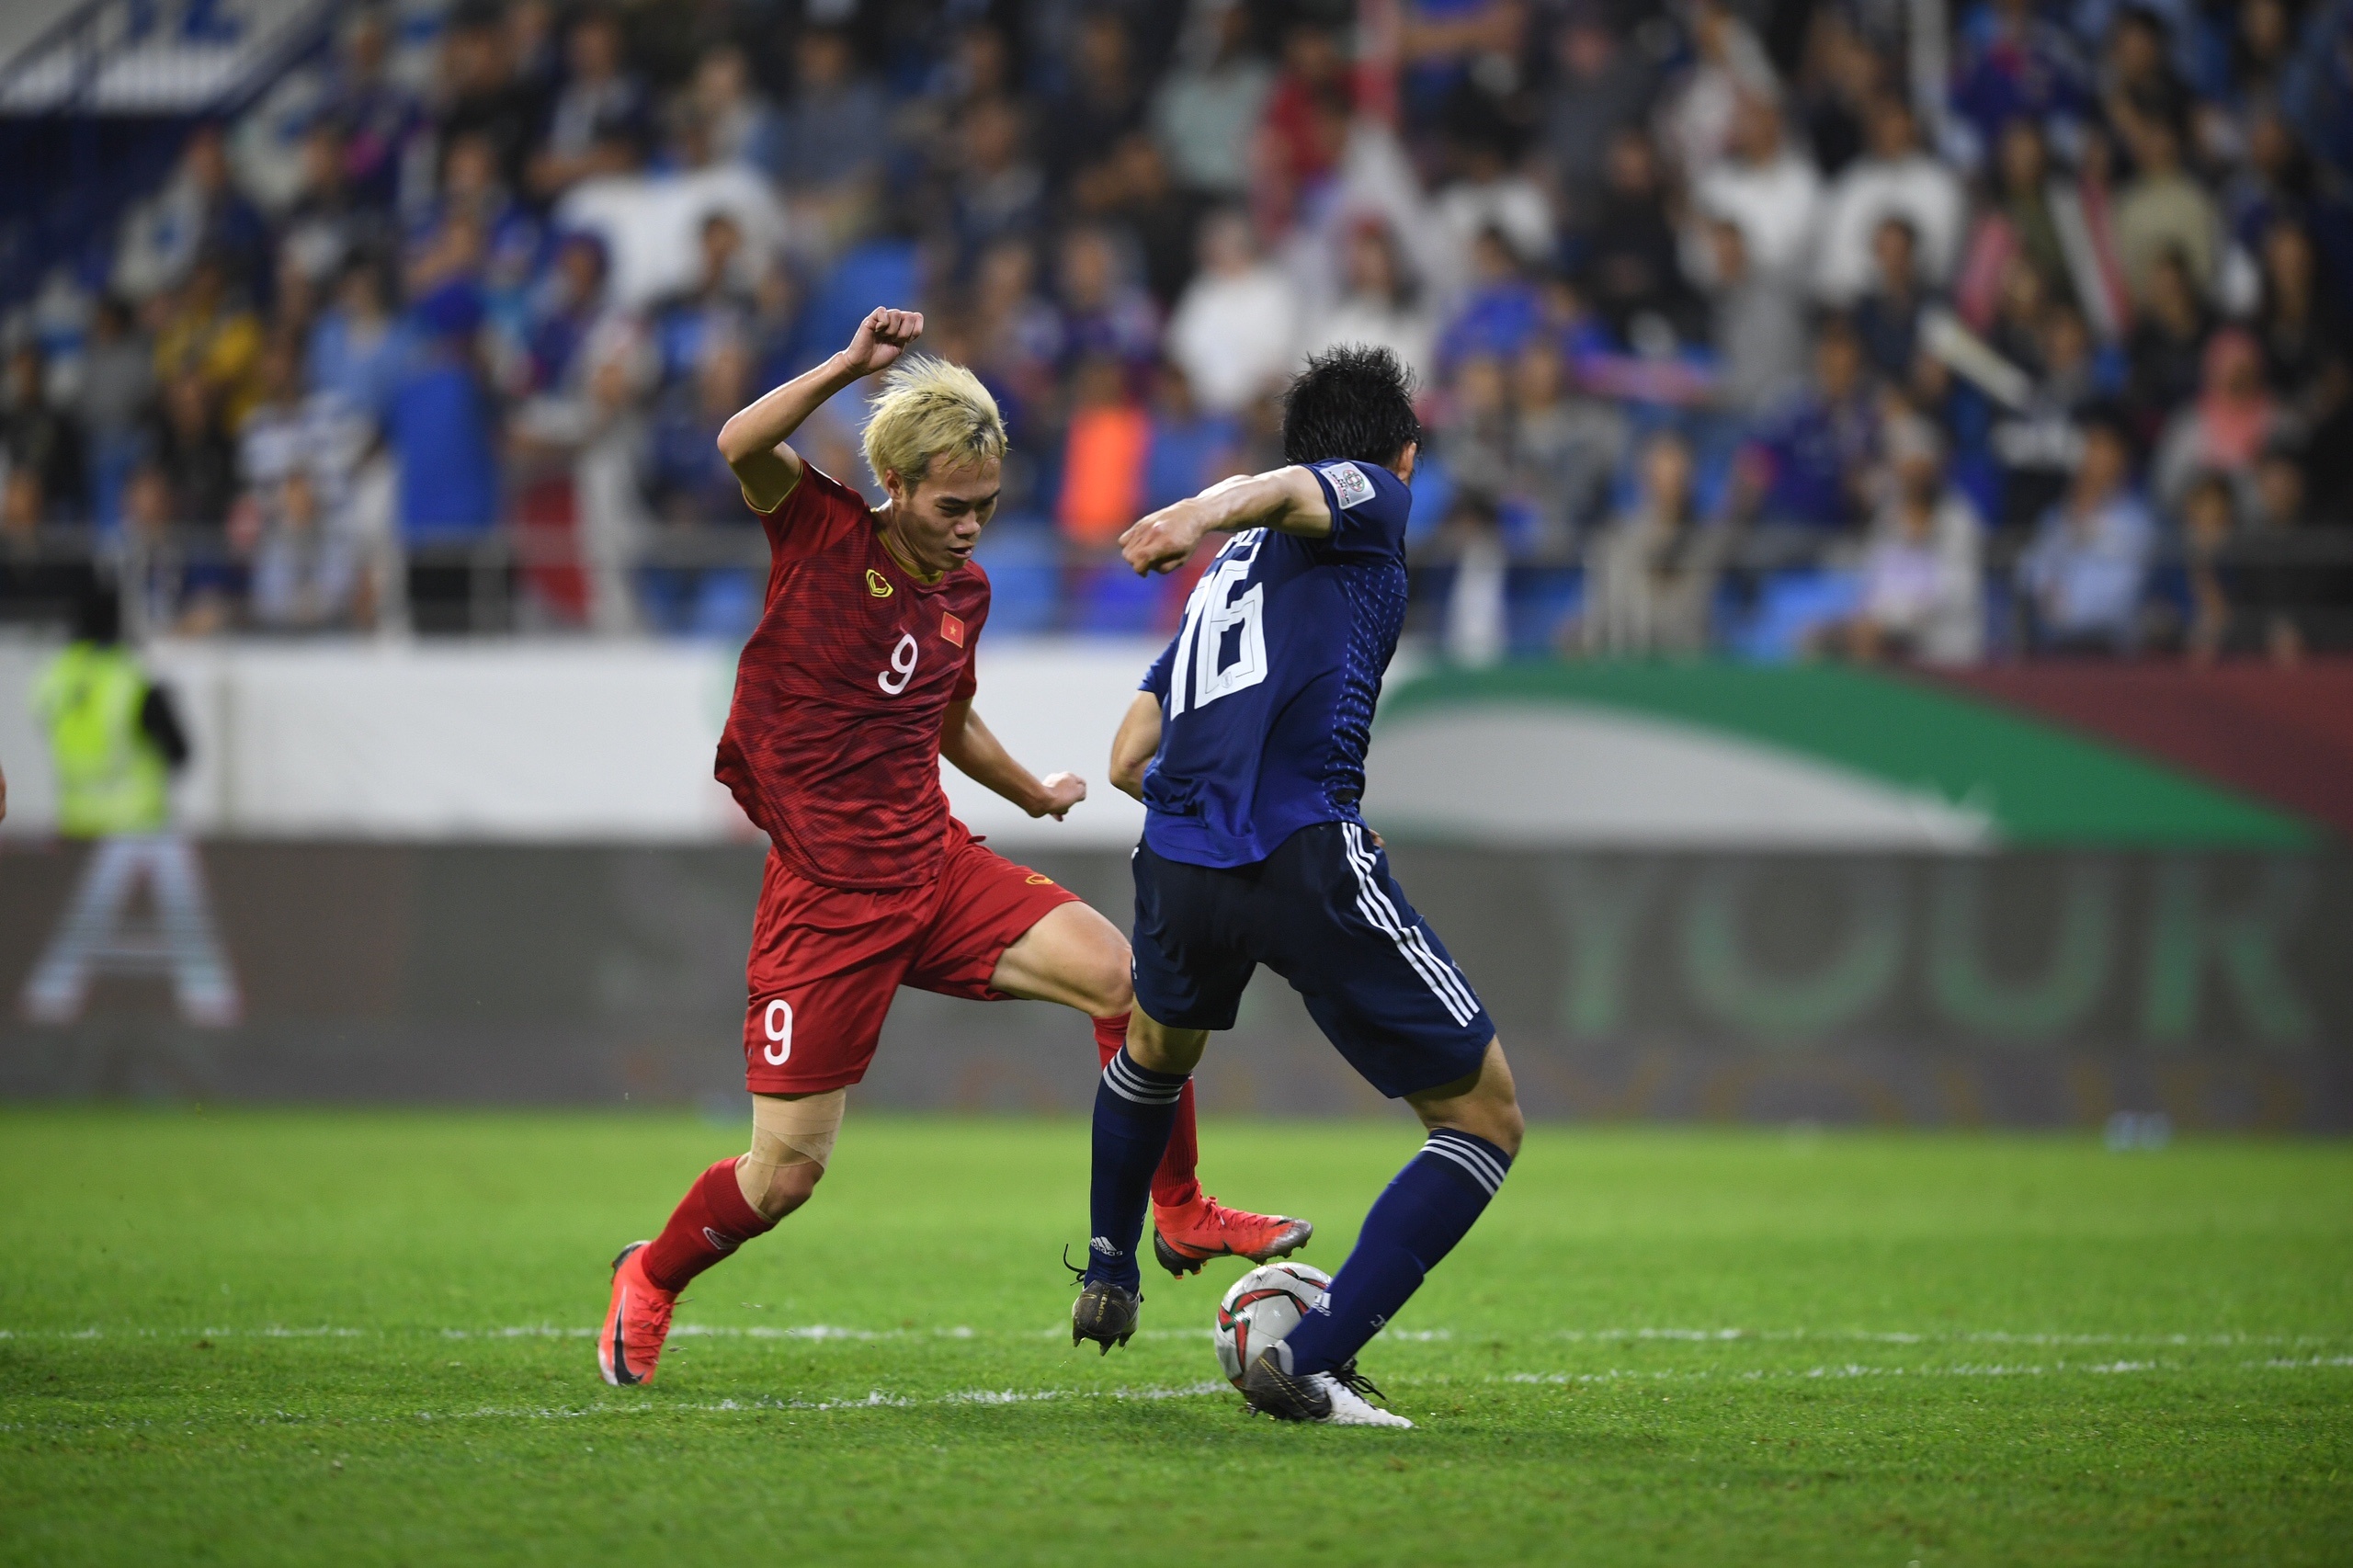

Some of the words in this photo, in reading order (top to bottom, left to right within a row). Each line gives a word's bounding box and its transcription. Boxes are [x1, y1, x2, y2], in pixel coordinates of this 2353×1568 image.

[878, 633, 918, 695] 9
[1170, 542, 1267, 722] 16
[1544, 855, 2313, 1040] YOUR
[764, 999, 793, 1065] 9
[1091, 1242, 1123, 1256] adidas
[1096, 1289, 1110, 1323] TIEMPO
